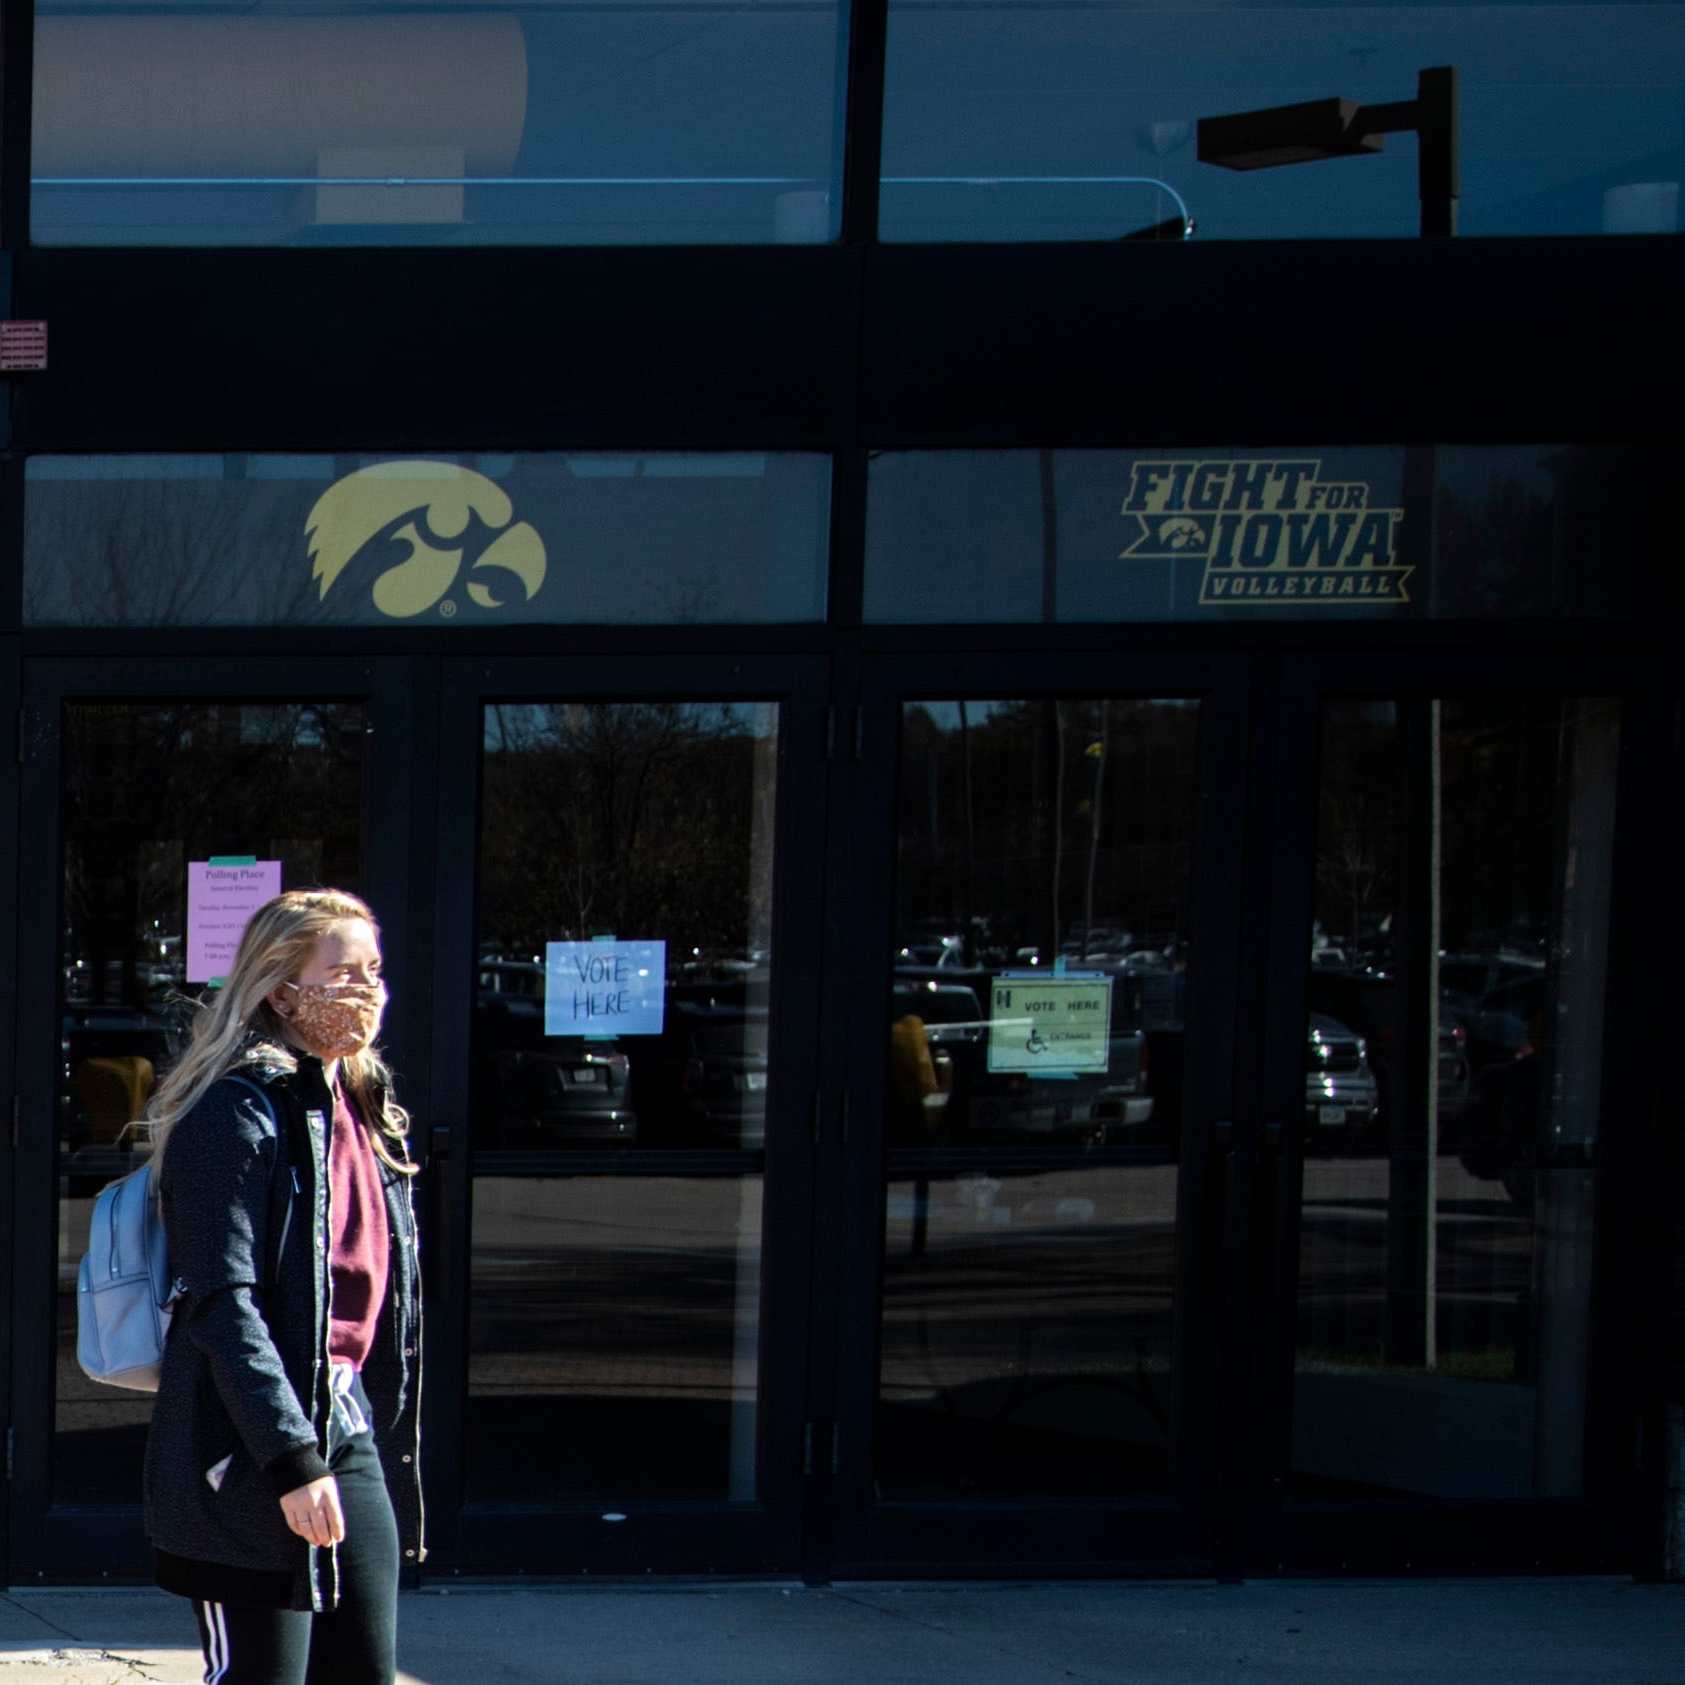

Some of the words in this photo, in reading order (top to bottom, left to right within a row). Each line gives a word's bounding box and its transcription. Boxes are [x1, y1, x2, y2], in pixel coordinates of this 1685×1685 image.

[1126, 462, 1316, 510] FIGHT
[1305, 485, 1365, 510] FOR
[1211, 512, 1391, 568] IOWA
[1213, 577, 1392, 596] VOLLEYBALL
[206, 870, 238, 880] Polling
[241, 870, 265, 879] Place
[575, 954, 629, 984] VOTE
[574, 989, 630, 1020] HERE
[1025, 1002, 1056, 1012] VOTE
[1068, 1000, 1100, 1011] HERE
